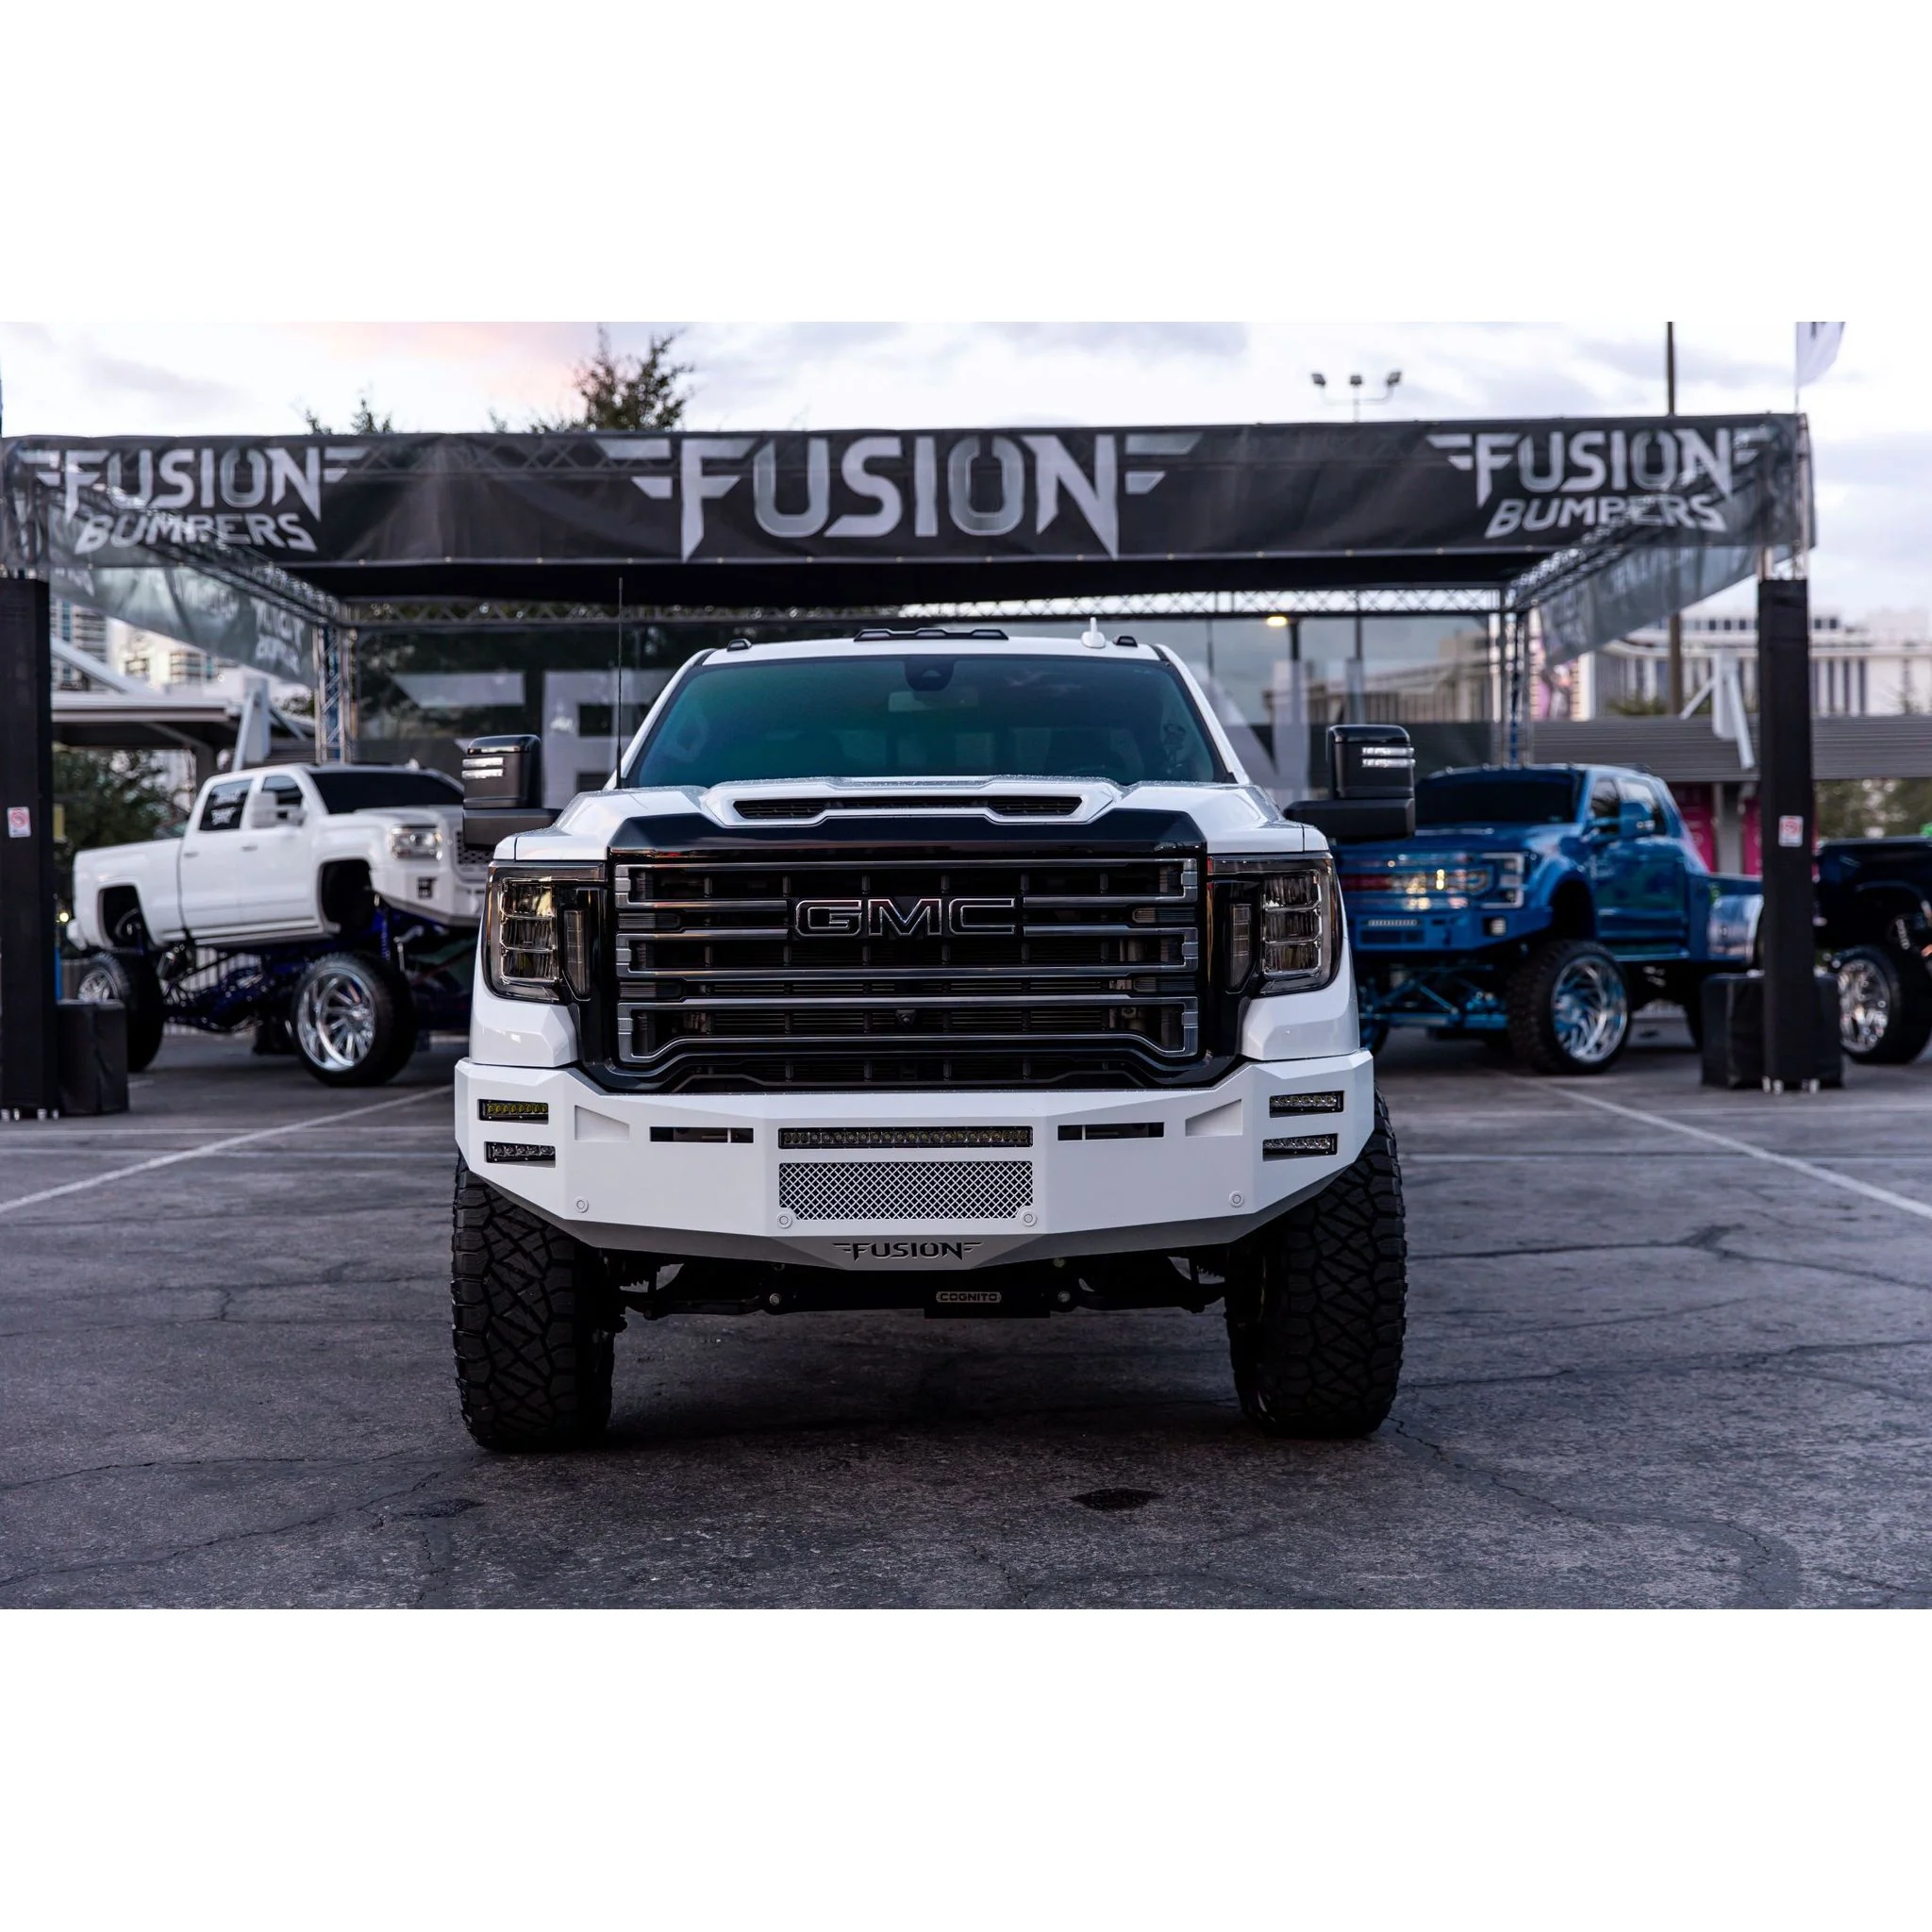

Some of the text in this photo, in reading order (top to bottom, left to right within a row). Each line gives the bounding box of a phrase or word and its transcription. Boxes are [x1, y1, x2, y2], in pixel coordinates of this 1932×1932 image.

[64, 446, 321, 523] FUSION
[1475, 427, 1733, 509] FUSION
[680, 434, 1120, 563] FUSION
[1484, 493, 1727, 539] BUMPERS
[75, 512, 318, 555] BUMPERS
[796, 898, 1016, 937] GMC
[852, 1241, 963, 1261] FUSION
[939, 1291, 998, 1302] COGNITO
